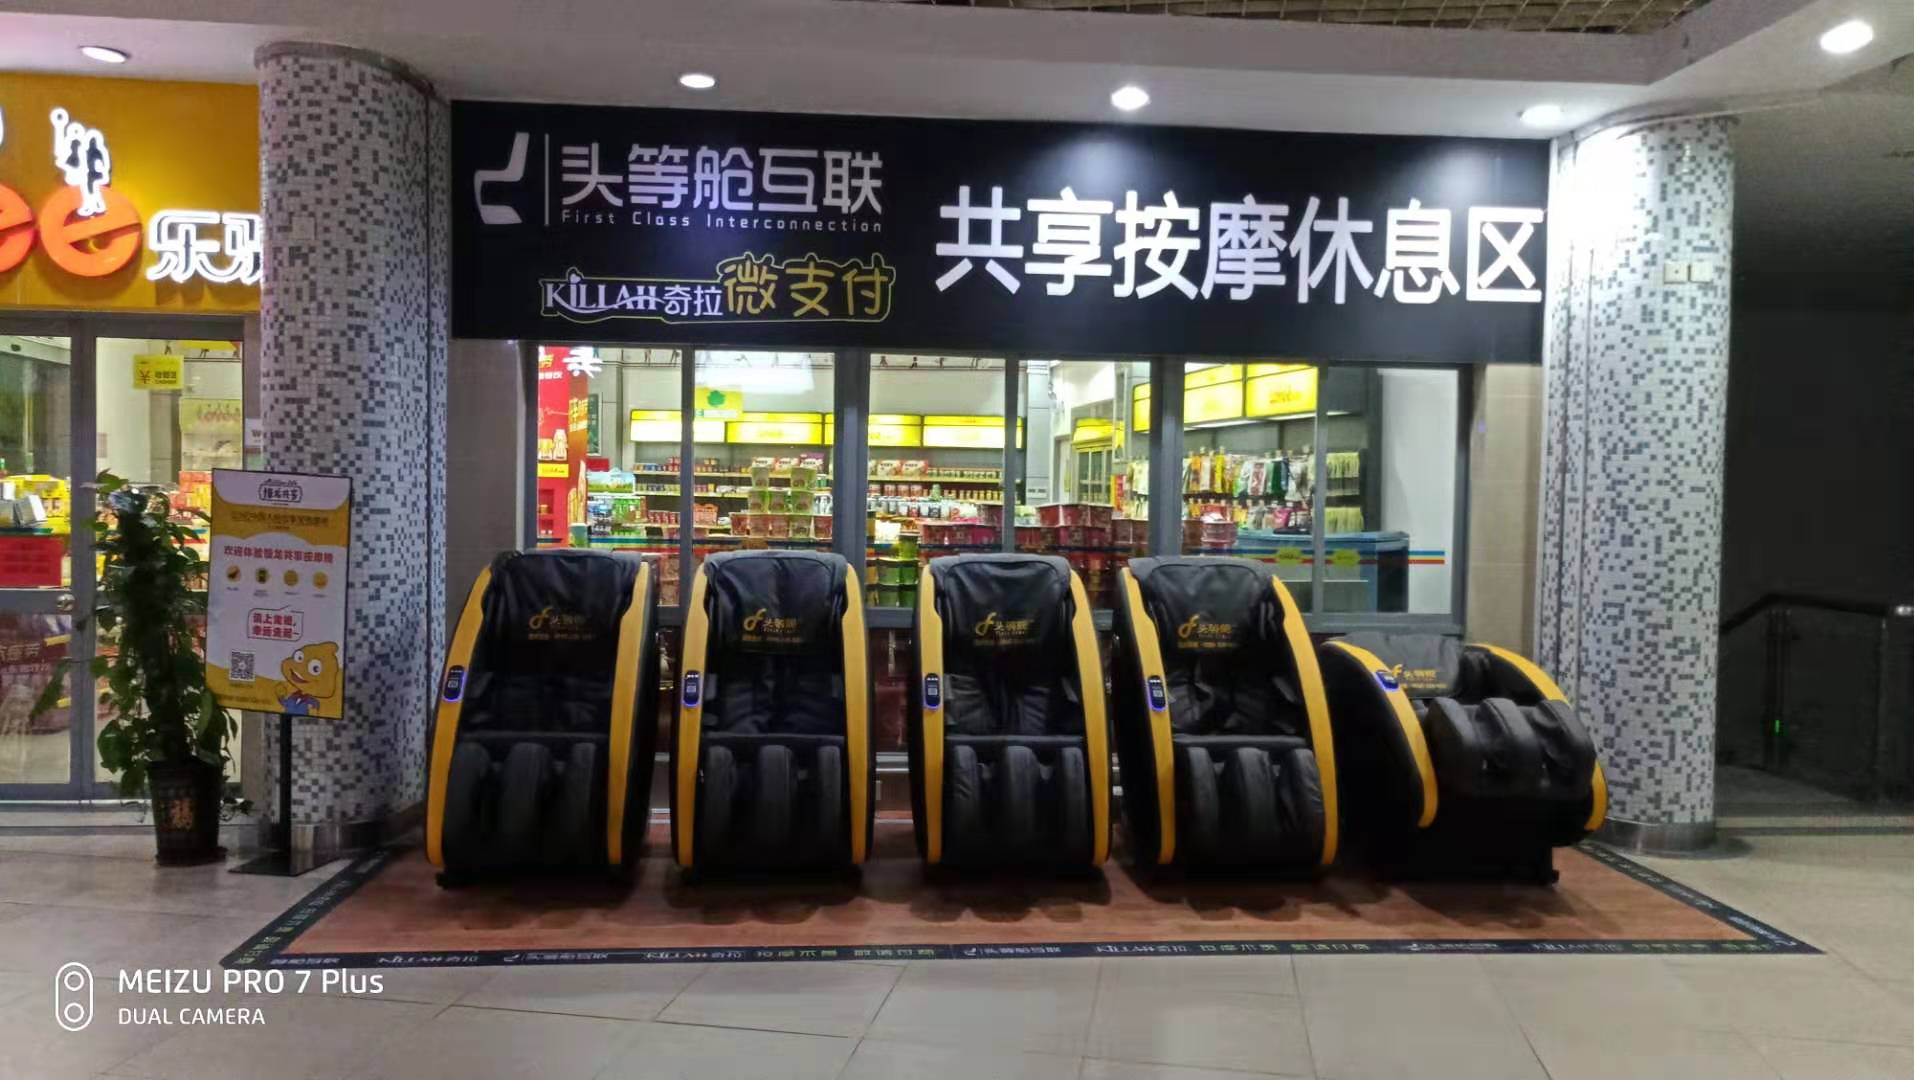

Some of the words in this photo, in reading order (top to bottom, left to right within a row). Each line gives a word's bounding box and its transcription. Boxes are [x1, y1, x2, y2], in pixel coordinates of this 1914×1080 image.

[561, 142, 883, 215] 头等舱互联
[561, 210, 616, 225] First
[632, 211, 690, 227] Class
[706, 213, 882, 233] Interconnection
[935, 186, 1545, 304] 共享按摩休息区
[722, 259, 889, 317] 微支付
